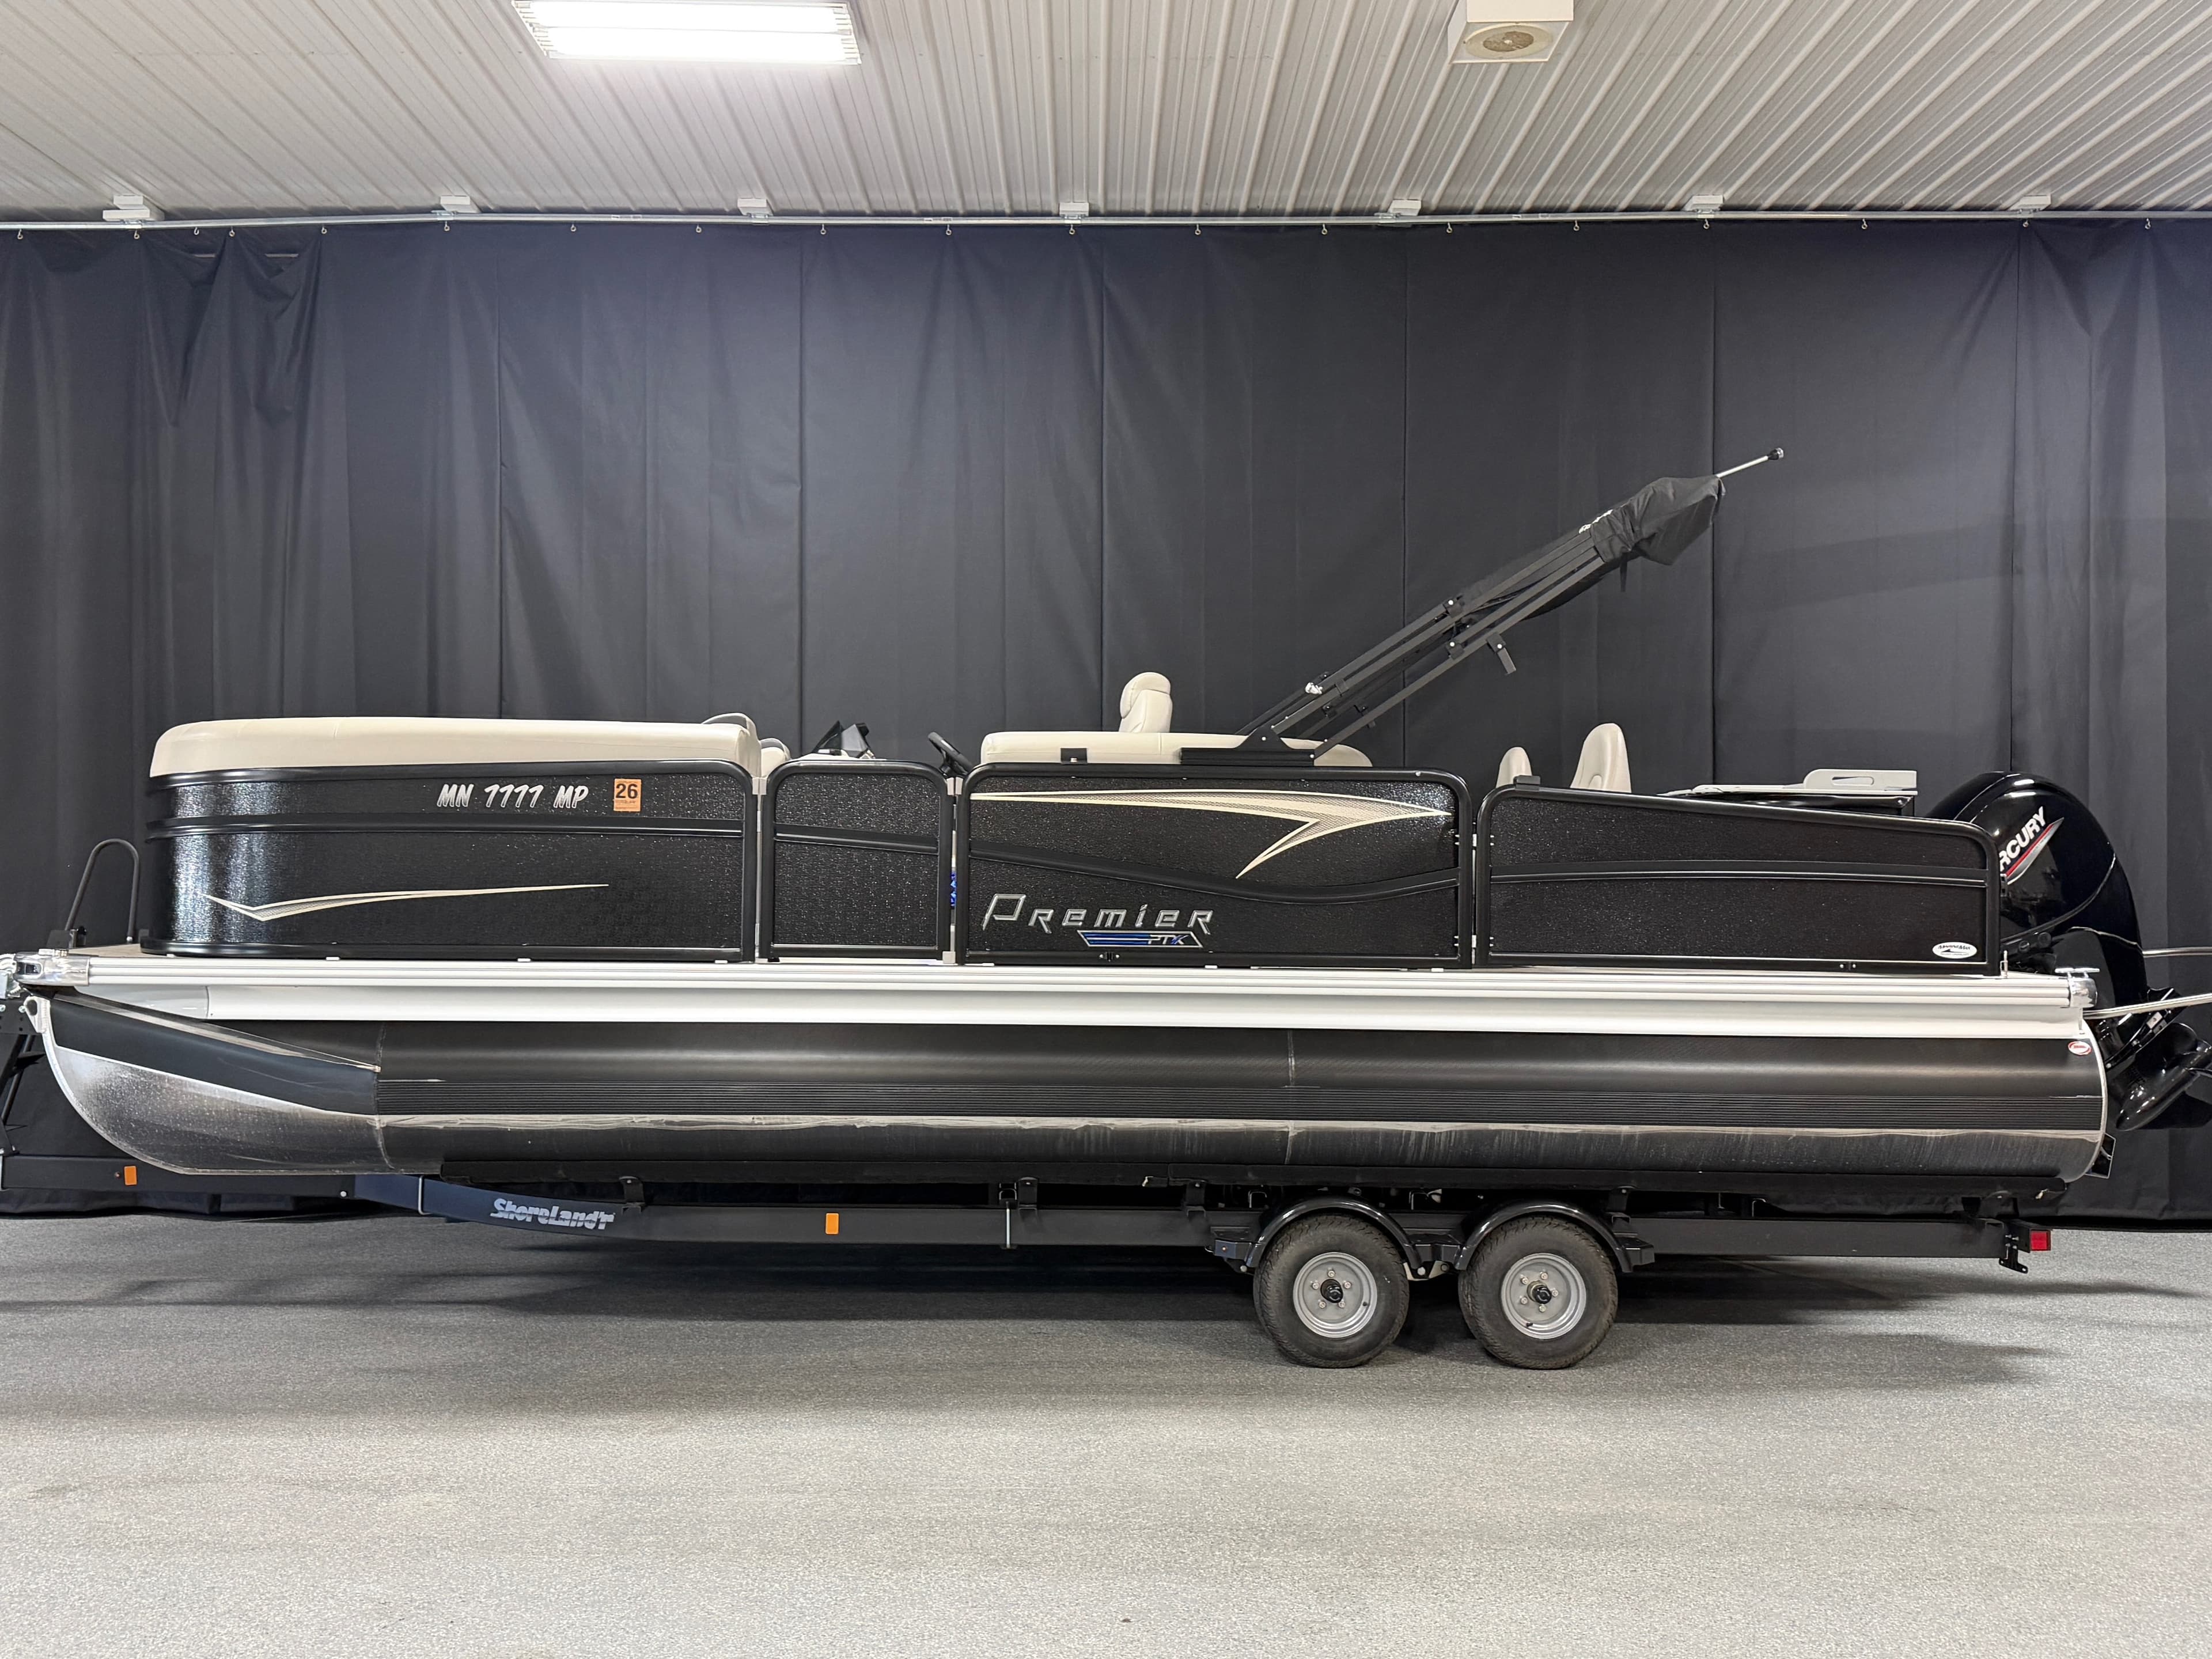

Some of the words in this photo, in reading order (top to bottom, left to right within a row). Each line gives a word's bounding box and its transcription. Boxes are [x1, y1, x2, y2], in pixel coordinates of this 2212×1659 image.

[436, 783, 474, 808] MN
[553, 785, 589, 809] MP
[616, 783, 638, 799] 26
[1999, 806, 2046, 872] RCURY
